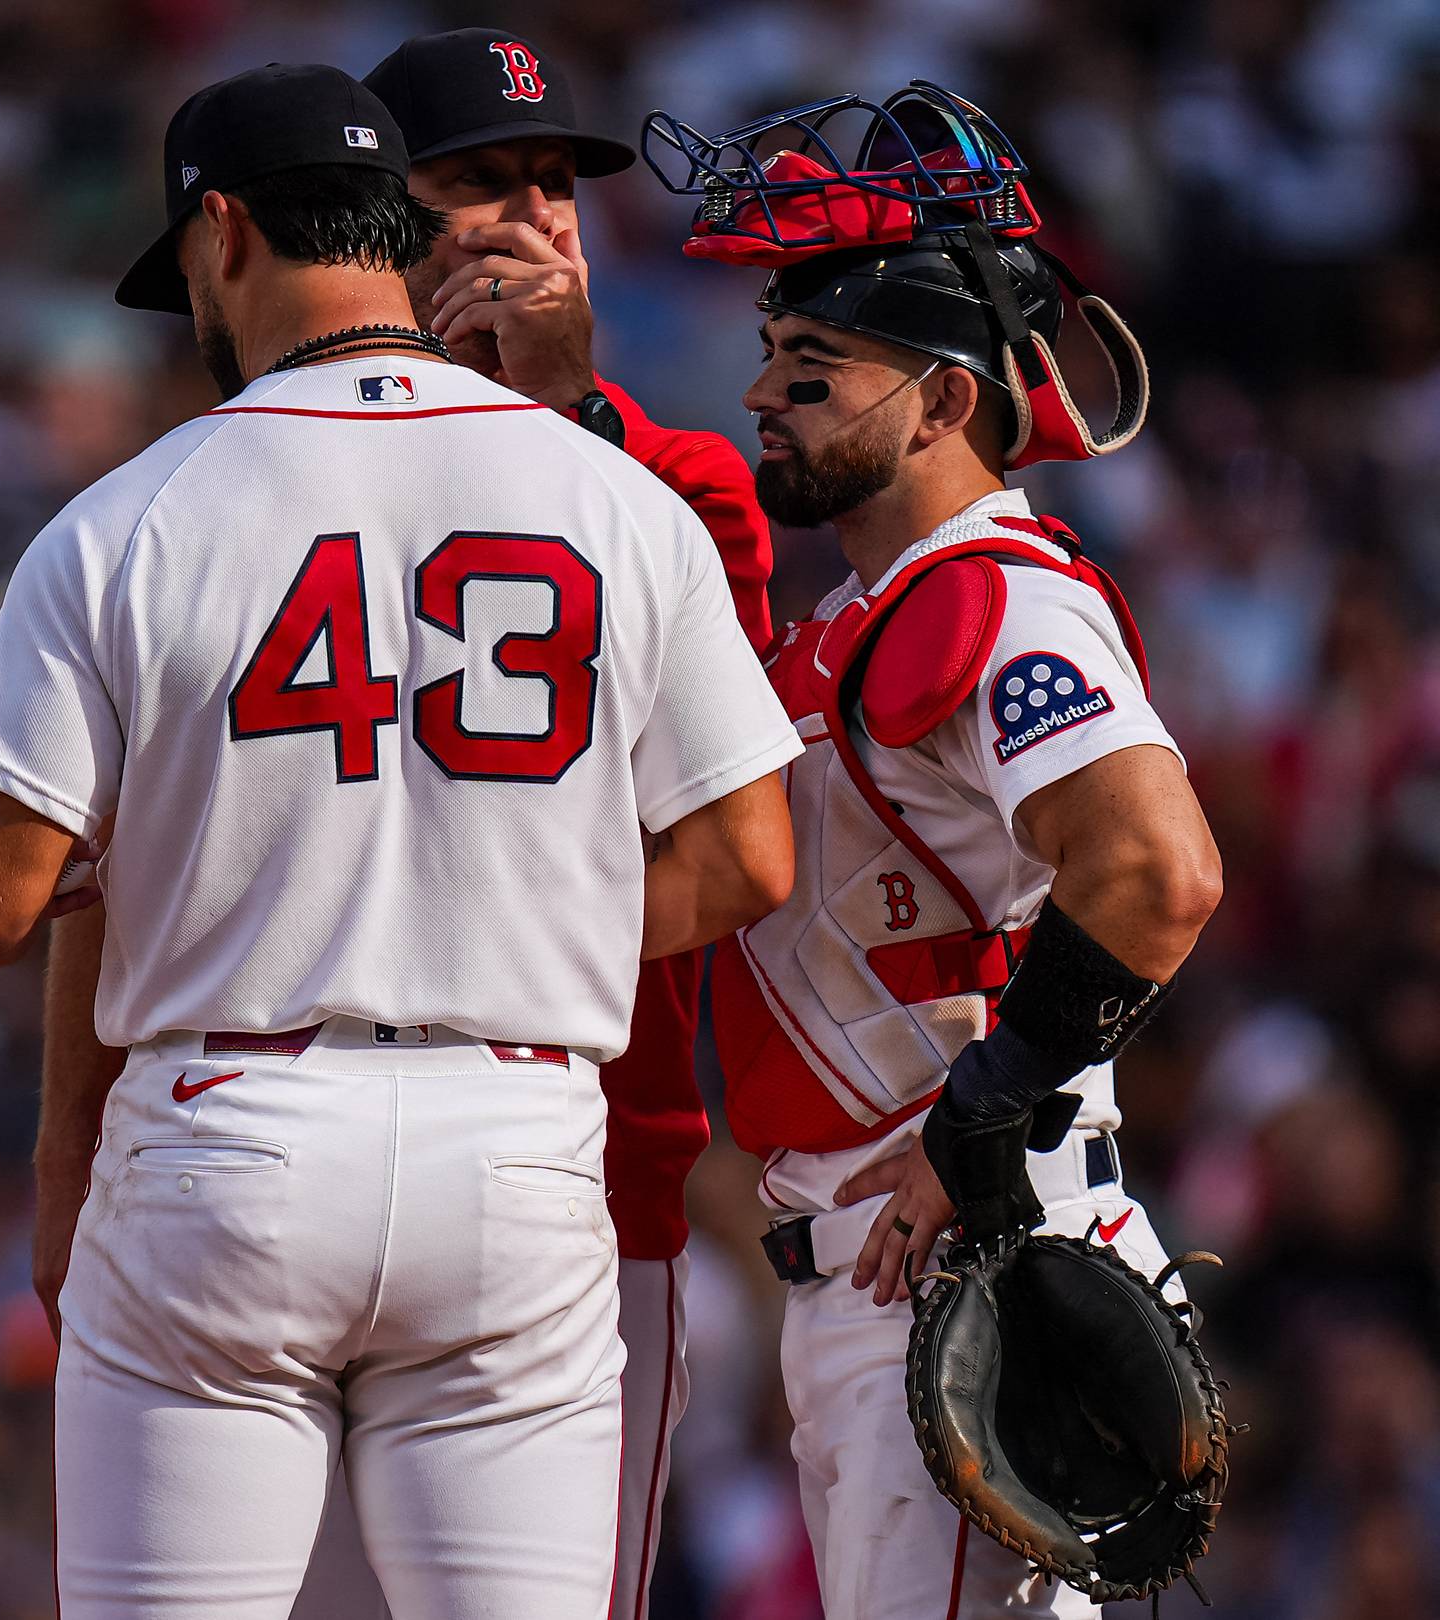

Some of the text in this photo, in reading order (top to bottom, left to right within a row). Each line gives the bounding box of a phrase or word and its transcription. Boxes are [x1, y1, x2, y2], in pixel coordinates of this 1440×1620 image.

[489, 41, 547, 103] B
[228, 530, 603, 784] 43
[998, 692, 1107, 757] MassMutual
[877, 870, 920, 931] B
